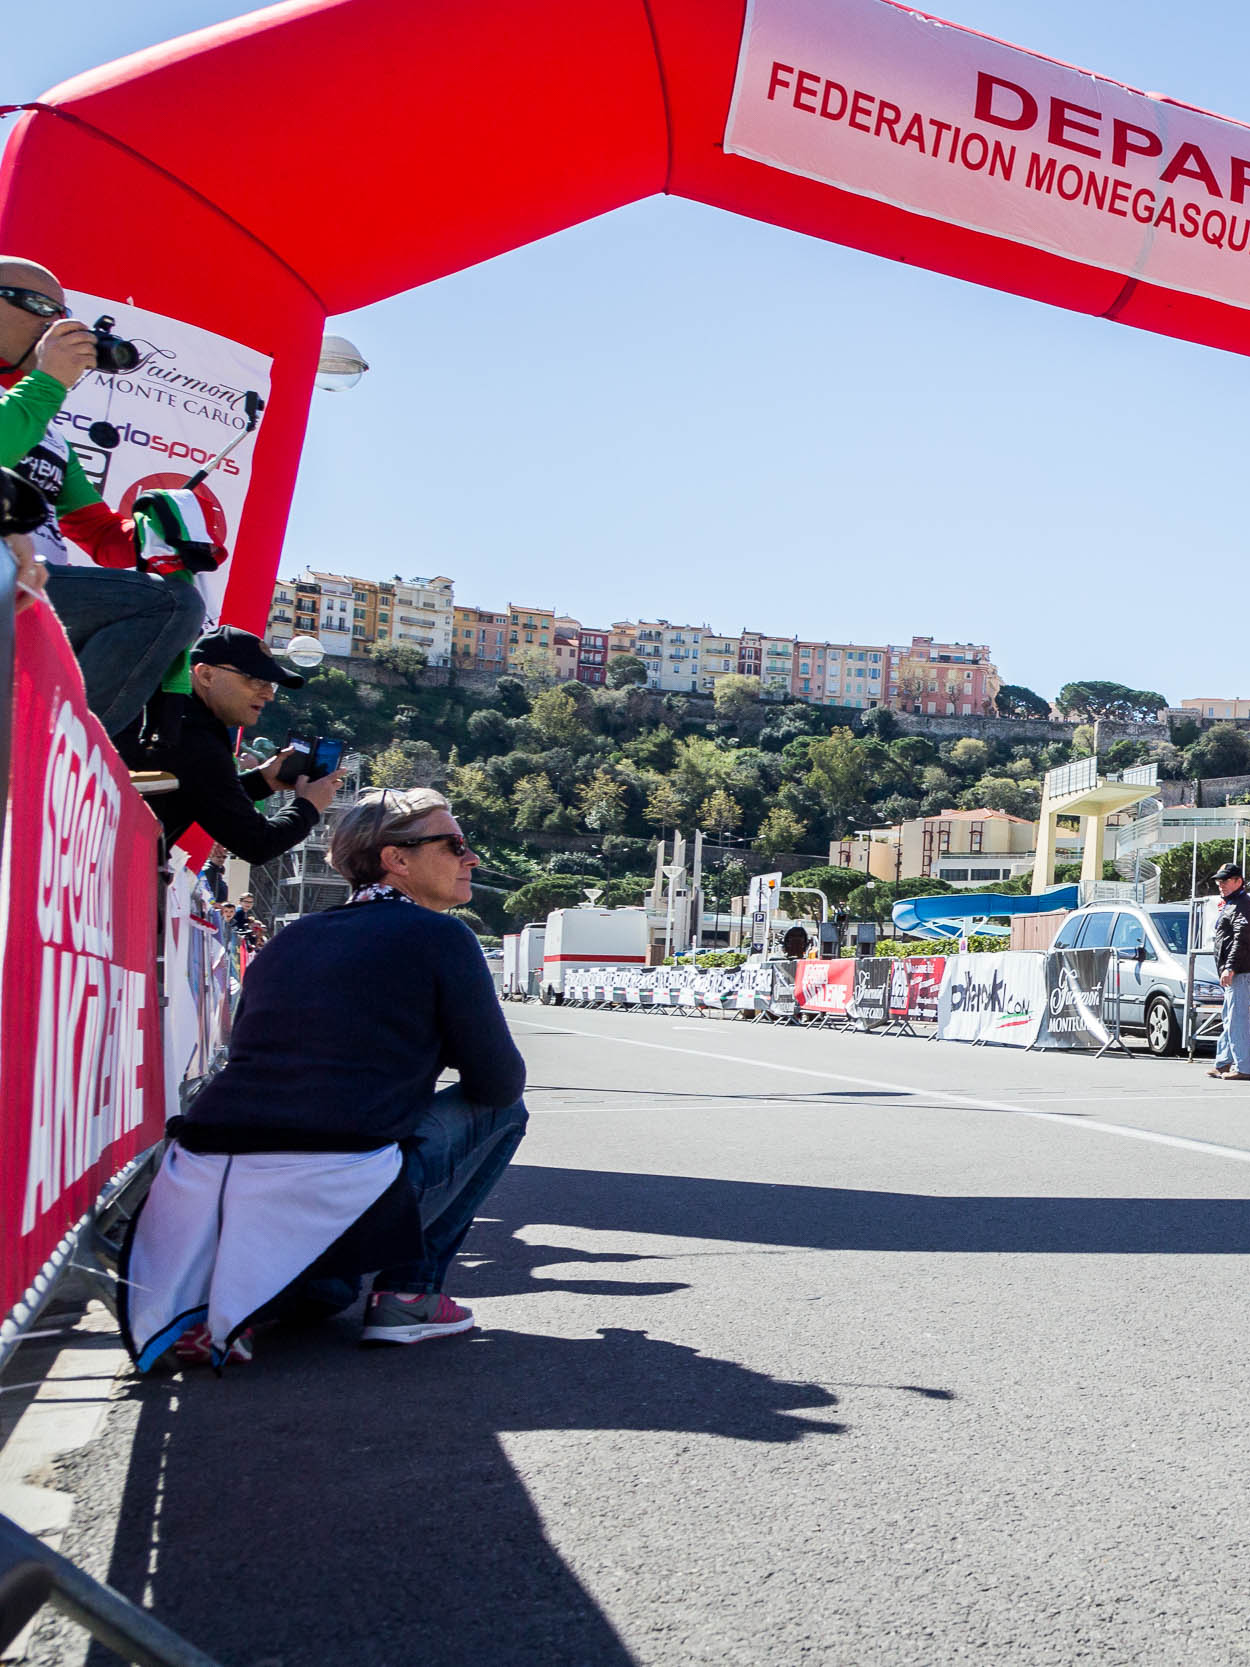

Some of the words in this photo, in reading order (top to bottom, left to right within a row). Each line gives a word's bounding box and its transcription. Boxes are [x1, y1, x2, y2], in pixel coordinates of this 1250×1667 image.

[767, 61, 1016, 181] FEDERATION
[95, 374, 177, 408] MONTE
[183, 400, 246, 431] CARLO
